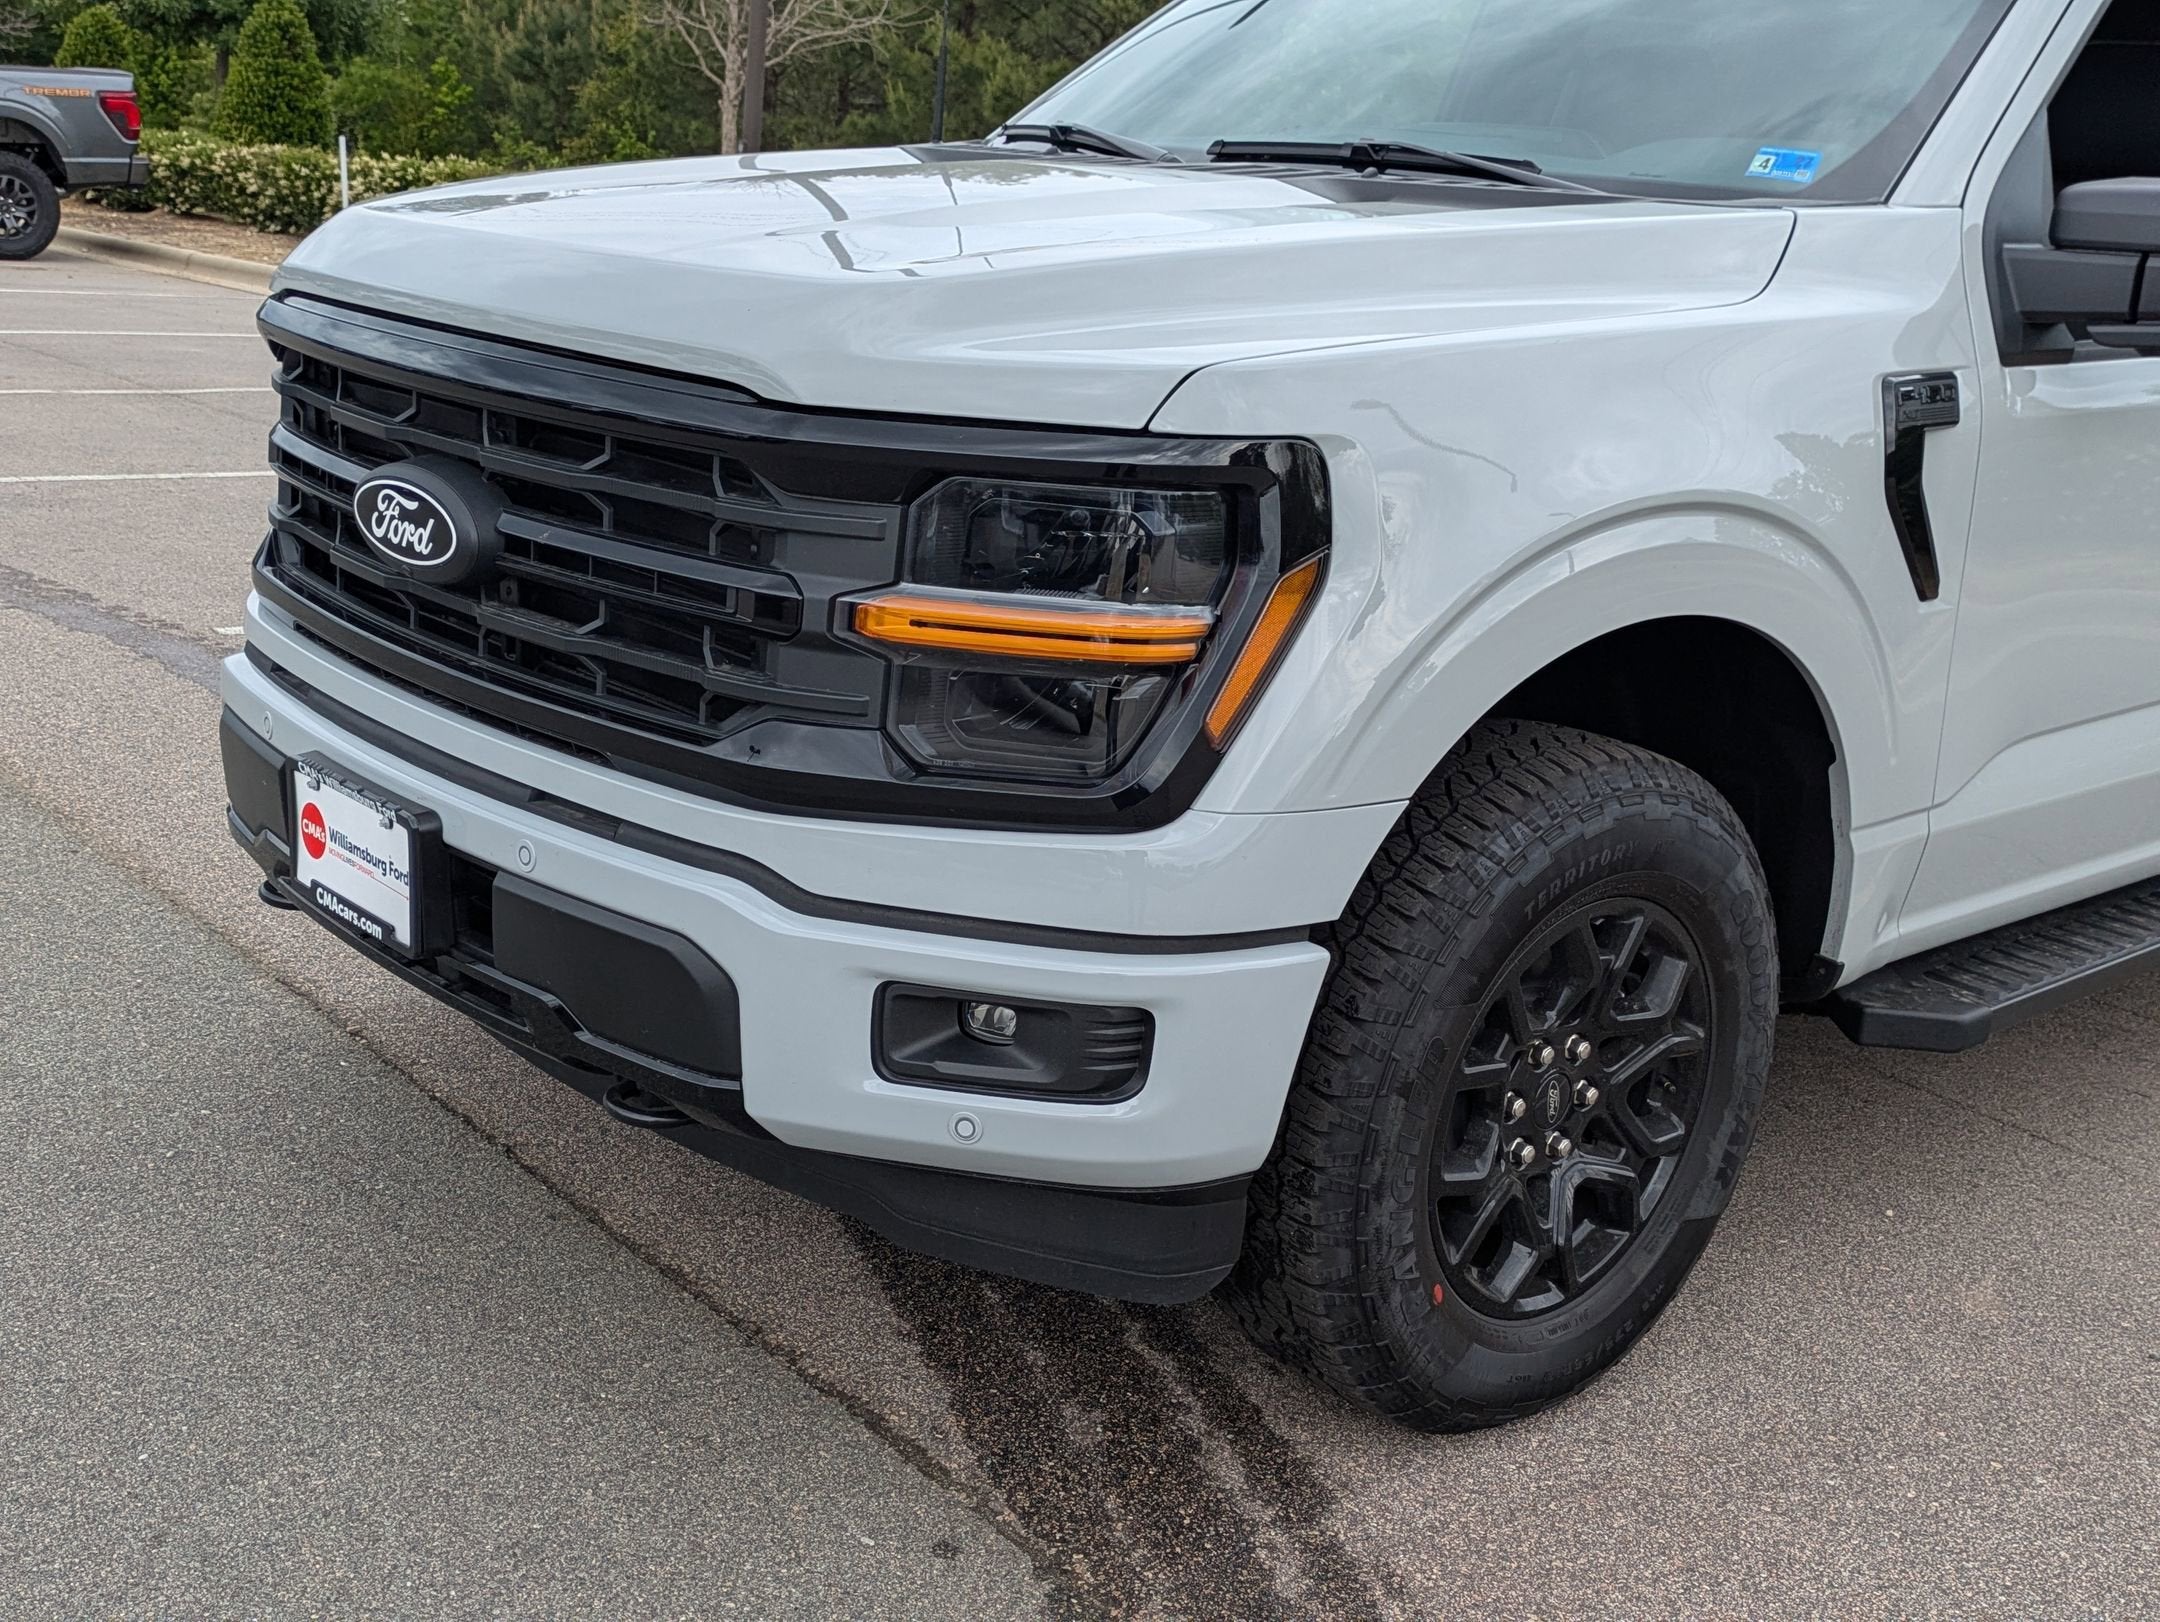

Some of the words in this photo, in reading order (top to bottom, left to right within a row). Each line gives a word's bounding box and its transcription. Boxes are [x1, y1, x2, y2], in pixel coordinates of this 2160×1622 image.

[23, 86, 91, 97] TREMOR
[1758, 157, 1771, 170] 4
[371, 488, 435, 555] Ford
[328, 825, 387, 877] Williamsburg
[388, 860, 409, 887] Ford
[1524, 839, 1640, 921] TERRITORY
[315, 887, 383, 941] CMAcars.com
